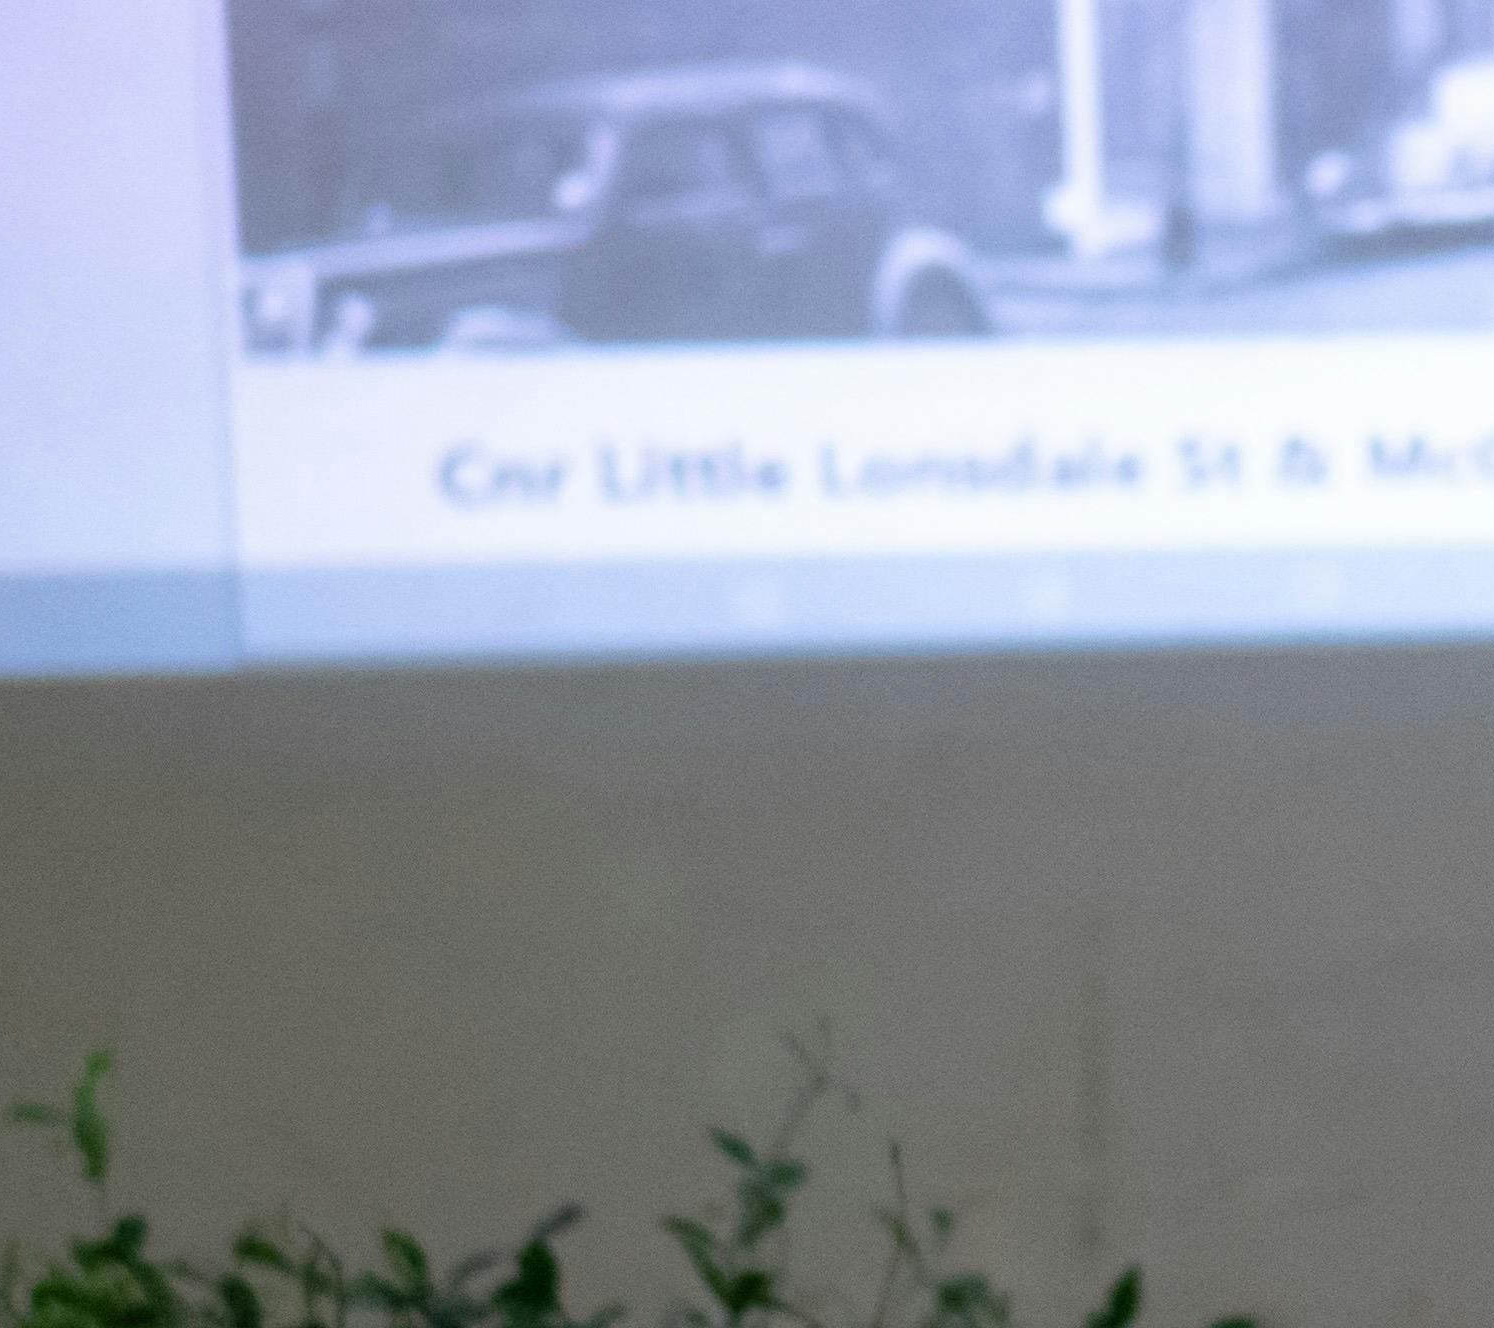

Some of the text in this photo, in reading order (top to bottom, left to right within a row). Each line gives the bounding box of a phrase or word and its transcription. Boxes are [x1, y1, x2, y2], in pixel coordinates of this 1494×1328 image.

[431, 438, 571, 514] Cnr
[596, 437, 797, 506] Little
[816, 432, 1149, 499] Lonsdale
[1174, 431, 1246, 493] St
[1273, 429, 1335, 491] &
